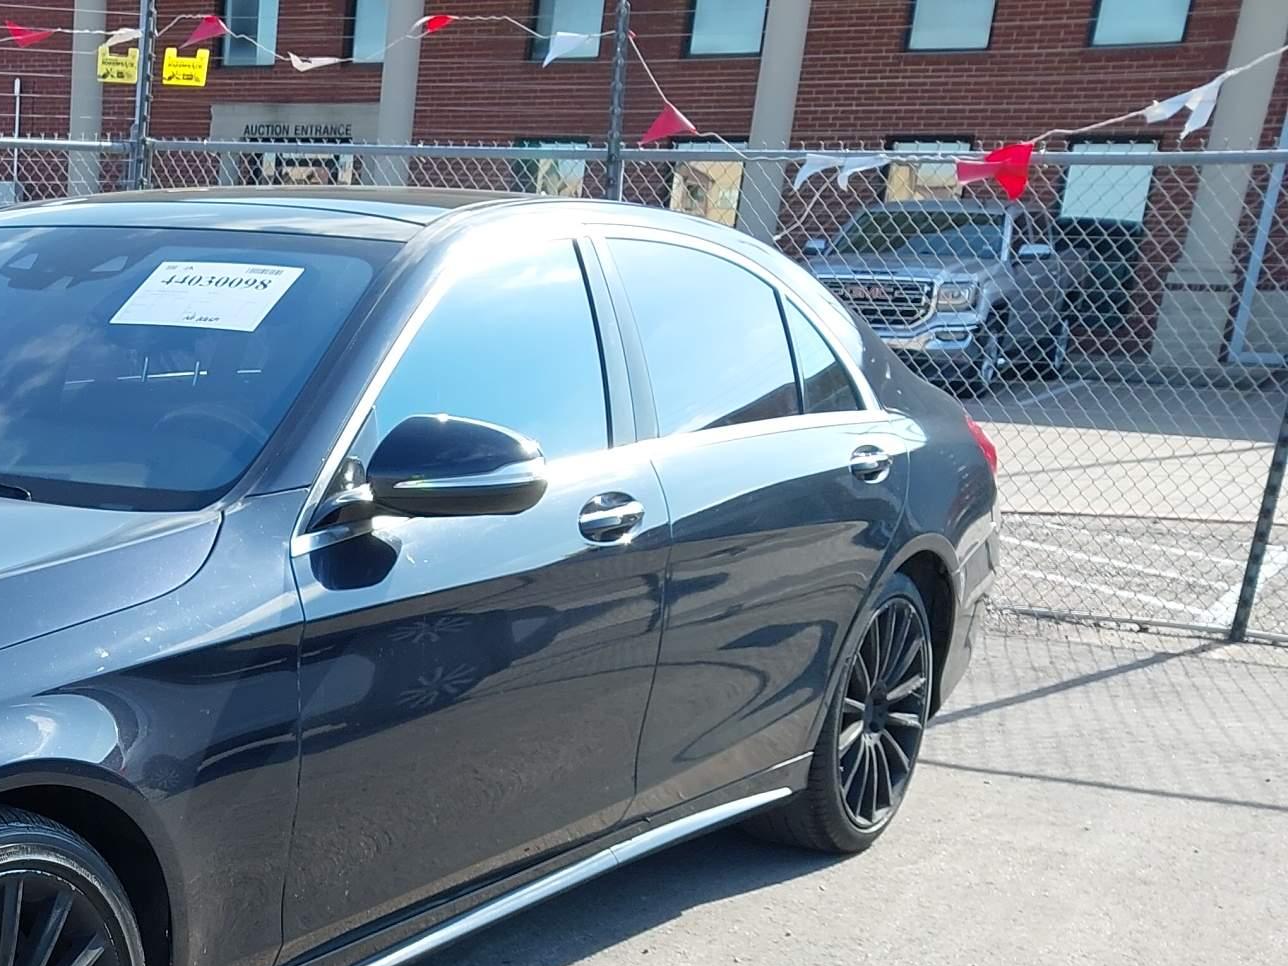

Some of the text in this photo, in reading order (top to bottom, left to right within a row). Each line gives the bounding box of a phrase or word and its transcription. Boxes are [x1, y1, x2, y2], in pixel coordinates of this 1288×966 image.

[243, 124, 352, 136] AUCTION ENTRANCE
[161, 274, 272, 291] 44030098
